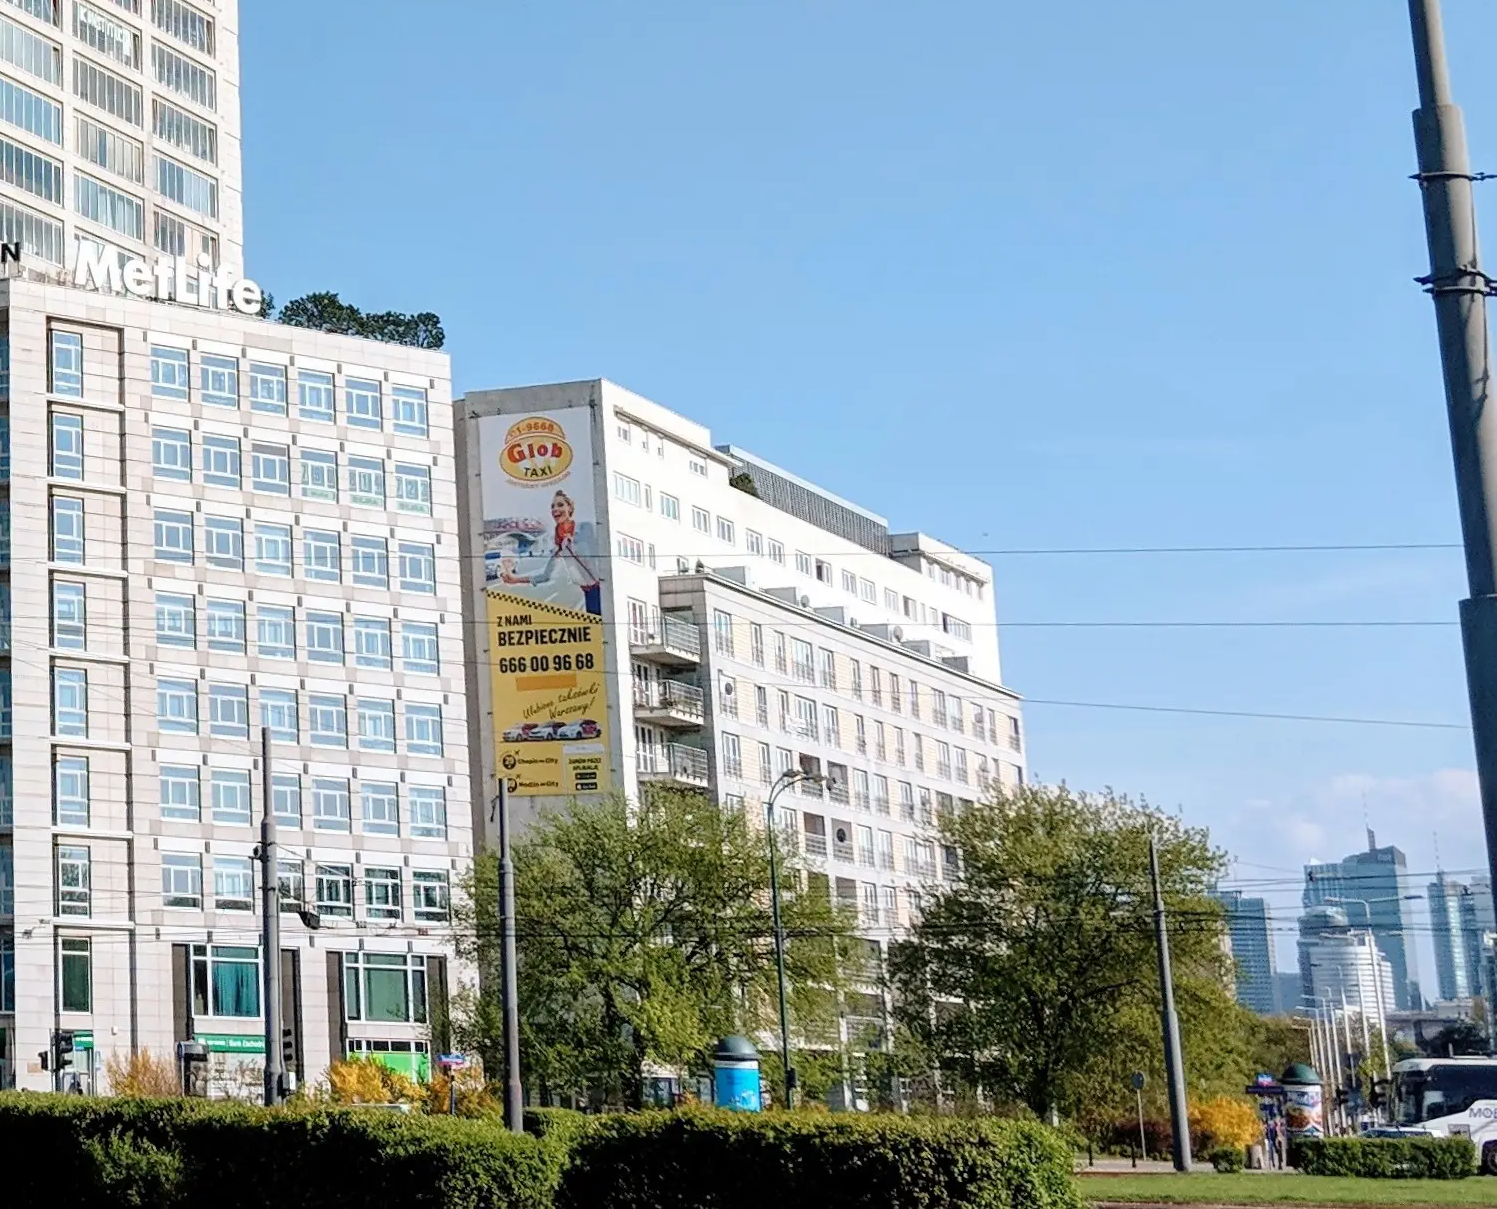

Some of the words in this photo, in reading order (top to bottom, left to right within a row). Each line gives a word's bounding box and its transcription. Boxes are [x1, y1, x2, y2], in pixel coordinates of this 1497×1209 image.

[75, 239, 263, 315] MetLife
[507, 442, 564, 465] Glob
[524, 465, 553, 478] TAXI
[497, 616, 503, 627] Z
[505, 615, 533, 626] NAMI
[498, 626, 592, 647] BEZPIECZNIE
[499, 657, 527, 674] 666
[530, 655, 550, 672] 00
[553, 654, 572, 671] 96
[576, 653, 594, 670] 68
